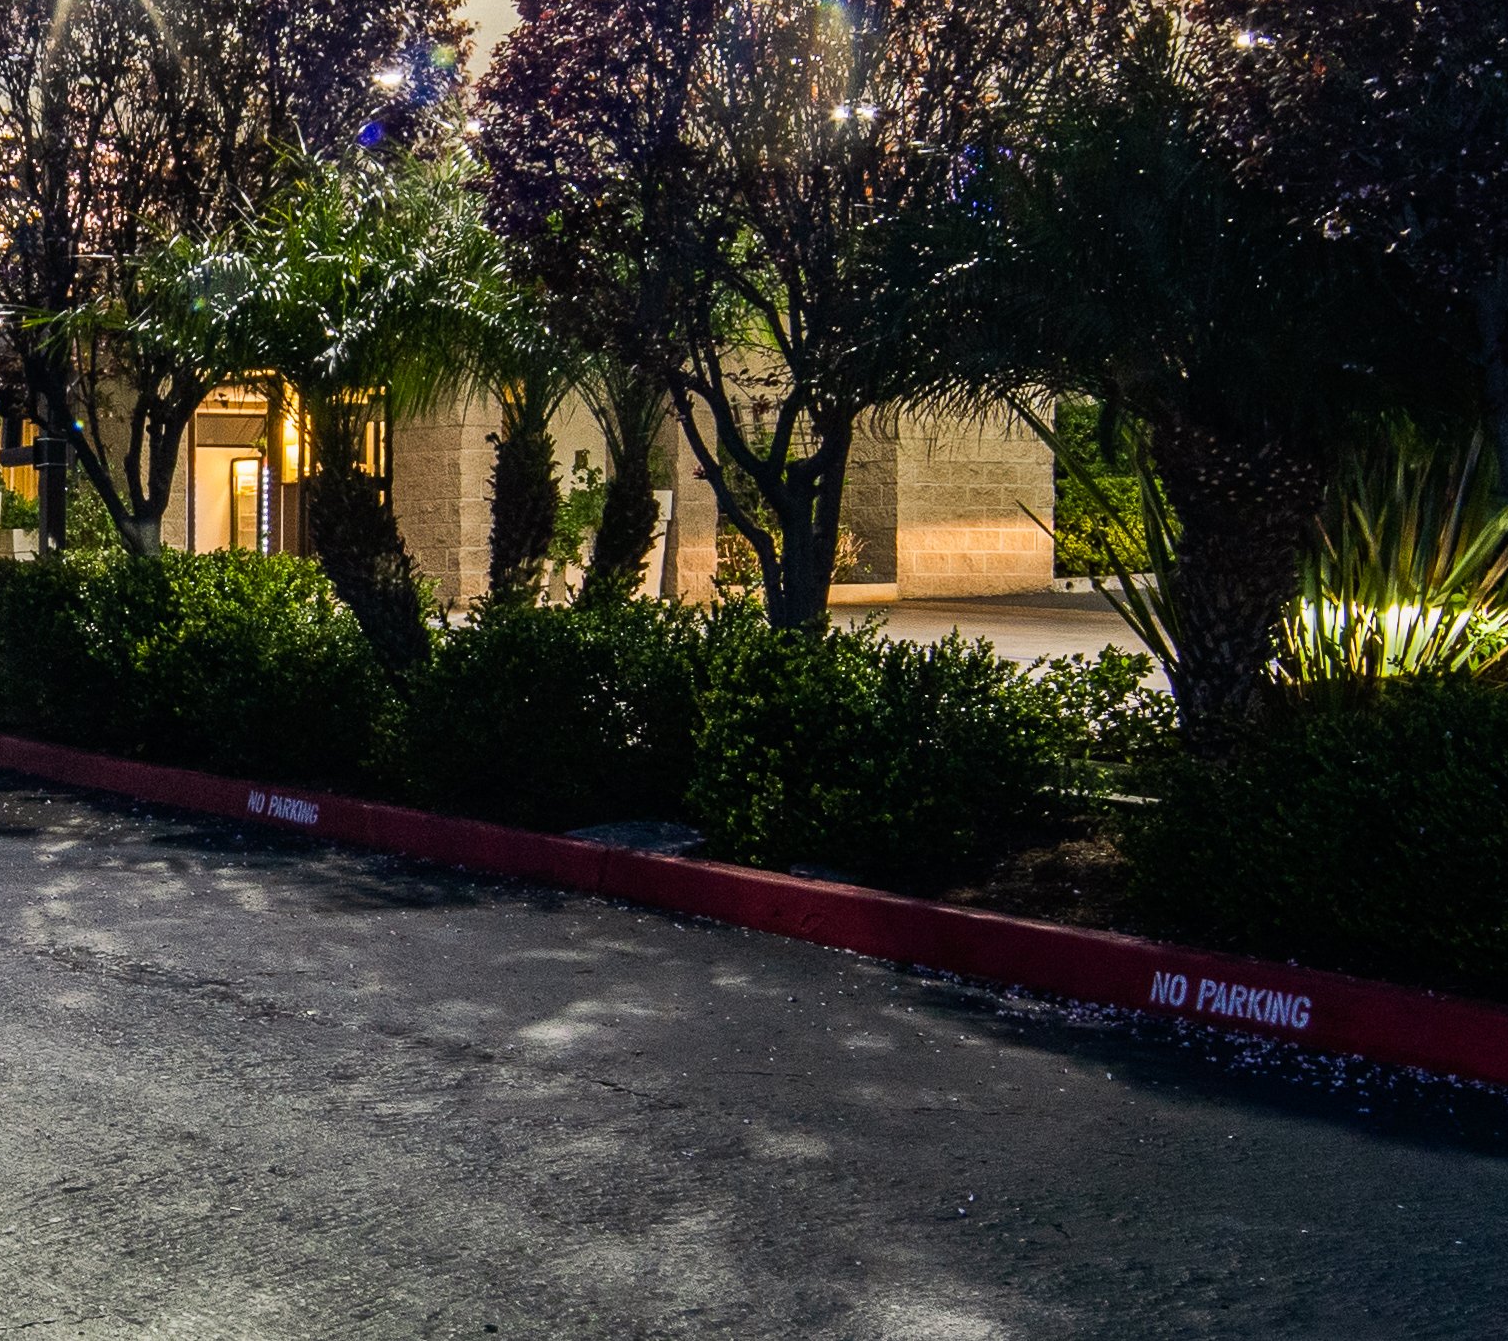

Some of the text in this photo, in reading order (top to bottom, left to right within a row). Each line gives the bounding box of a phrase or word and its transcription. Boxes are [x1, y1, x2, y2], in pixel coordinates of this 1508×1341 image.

[247, 790, 320, 825] NO PARKING
[1150, 970, 1312, 1029] NO PARKING
